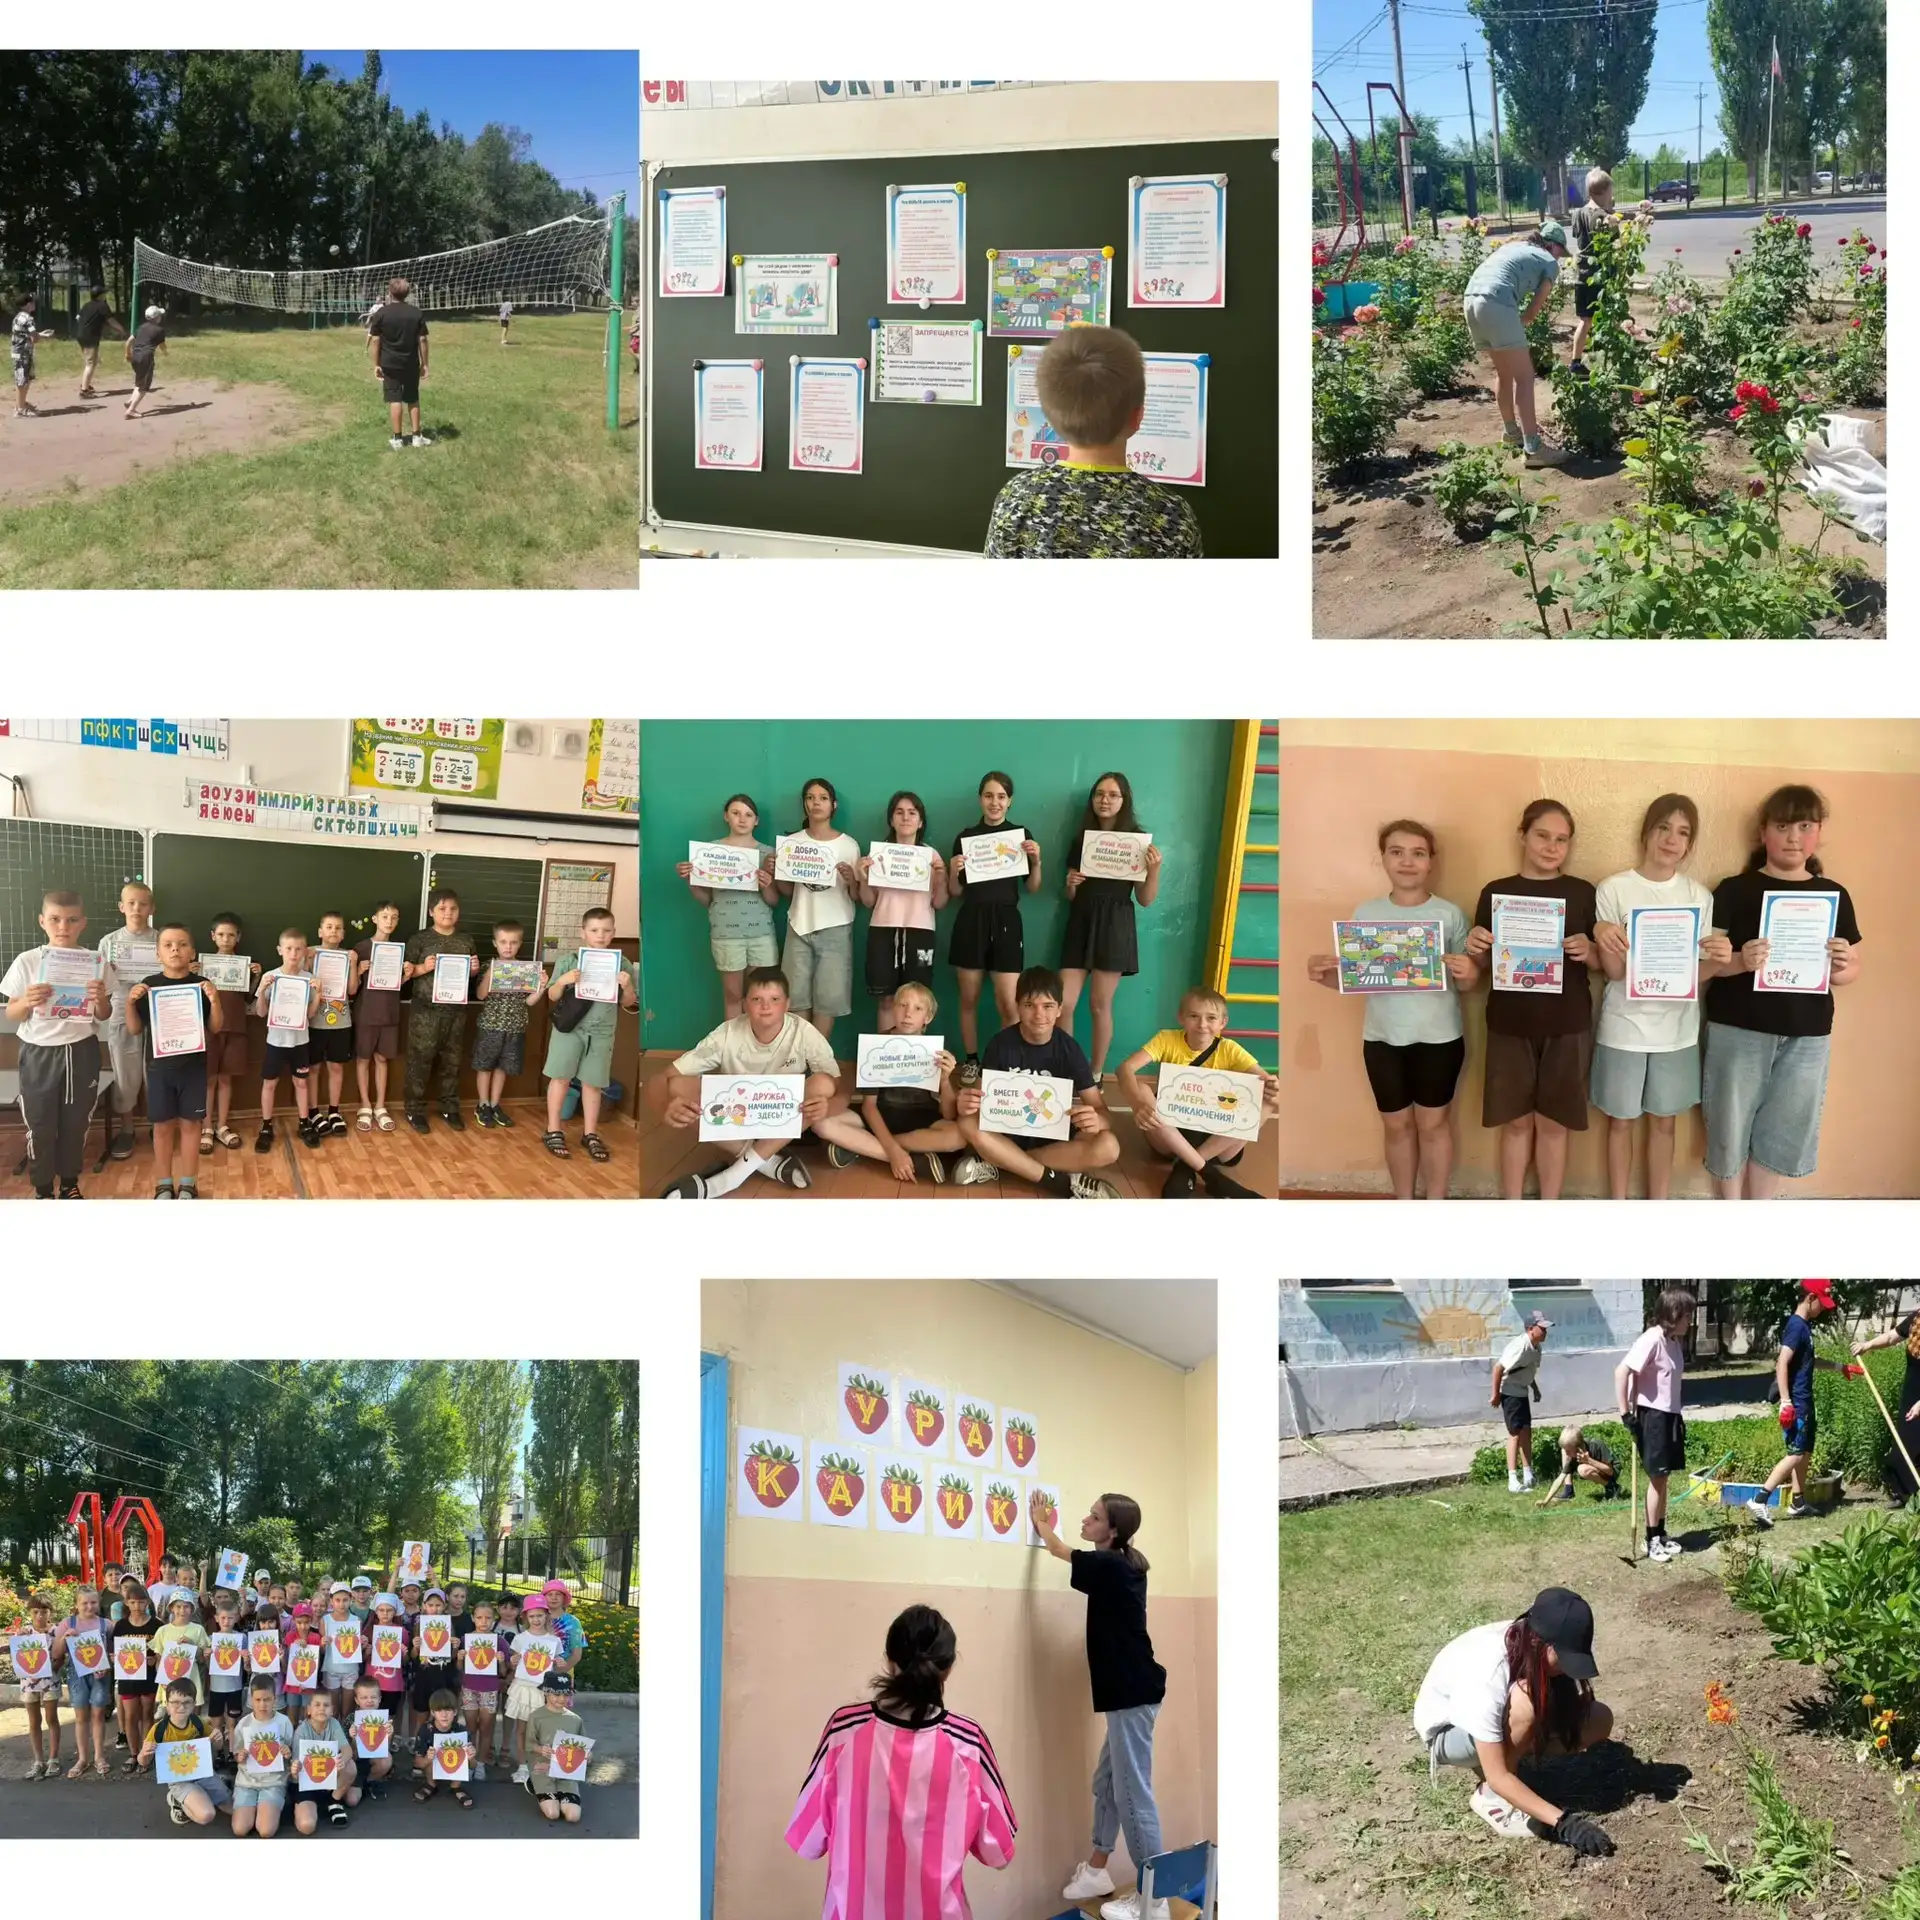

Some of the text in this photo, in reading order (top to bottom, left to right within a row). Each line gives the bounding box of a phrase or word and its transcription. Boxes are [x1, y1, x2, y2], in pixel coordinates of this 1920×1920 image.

[915, 329, 969, 338] ЗАПРЕЩАЕТСЯ
[794, 845, 818, 855] ДОБРО
[703, 852, 727, 860] КАЖДЫЙ
[787, 854, 825, 862] ПОЖАЛОВАТЬ
[792, 861, 826, 870] ЛАГЕРНУЮ
[791, 868, 821, 878] СМЕНУ!
[752, 1092, 786, 1101] ДРУЖБА
[993, 1089, 1018, 1097] ВМЕСТЕ
[748, 1102, 794, 1110] НАЧИНАЕТСЯ
[757, 1111, 783, 1120] ЗДЕСЬ!
[989, 1108, 1023, 1116] КОМАНДА!
[1168, 1103, 1235, 1123] ПРИКЛЮЧЕНИЯ!
